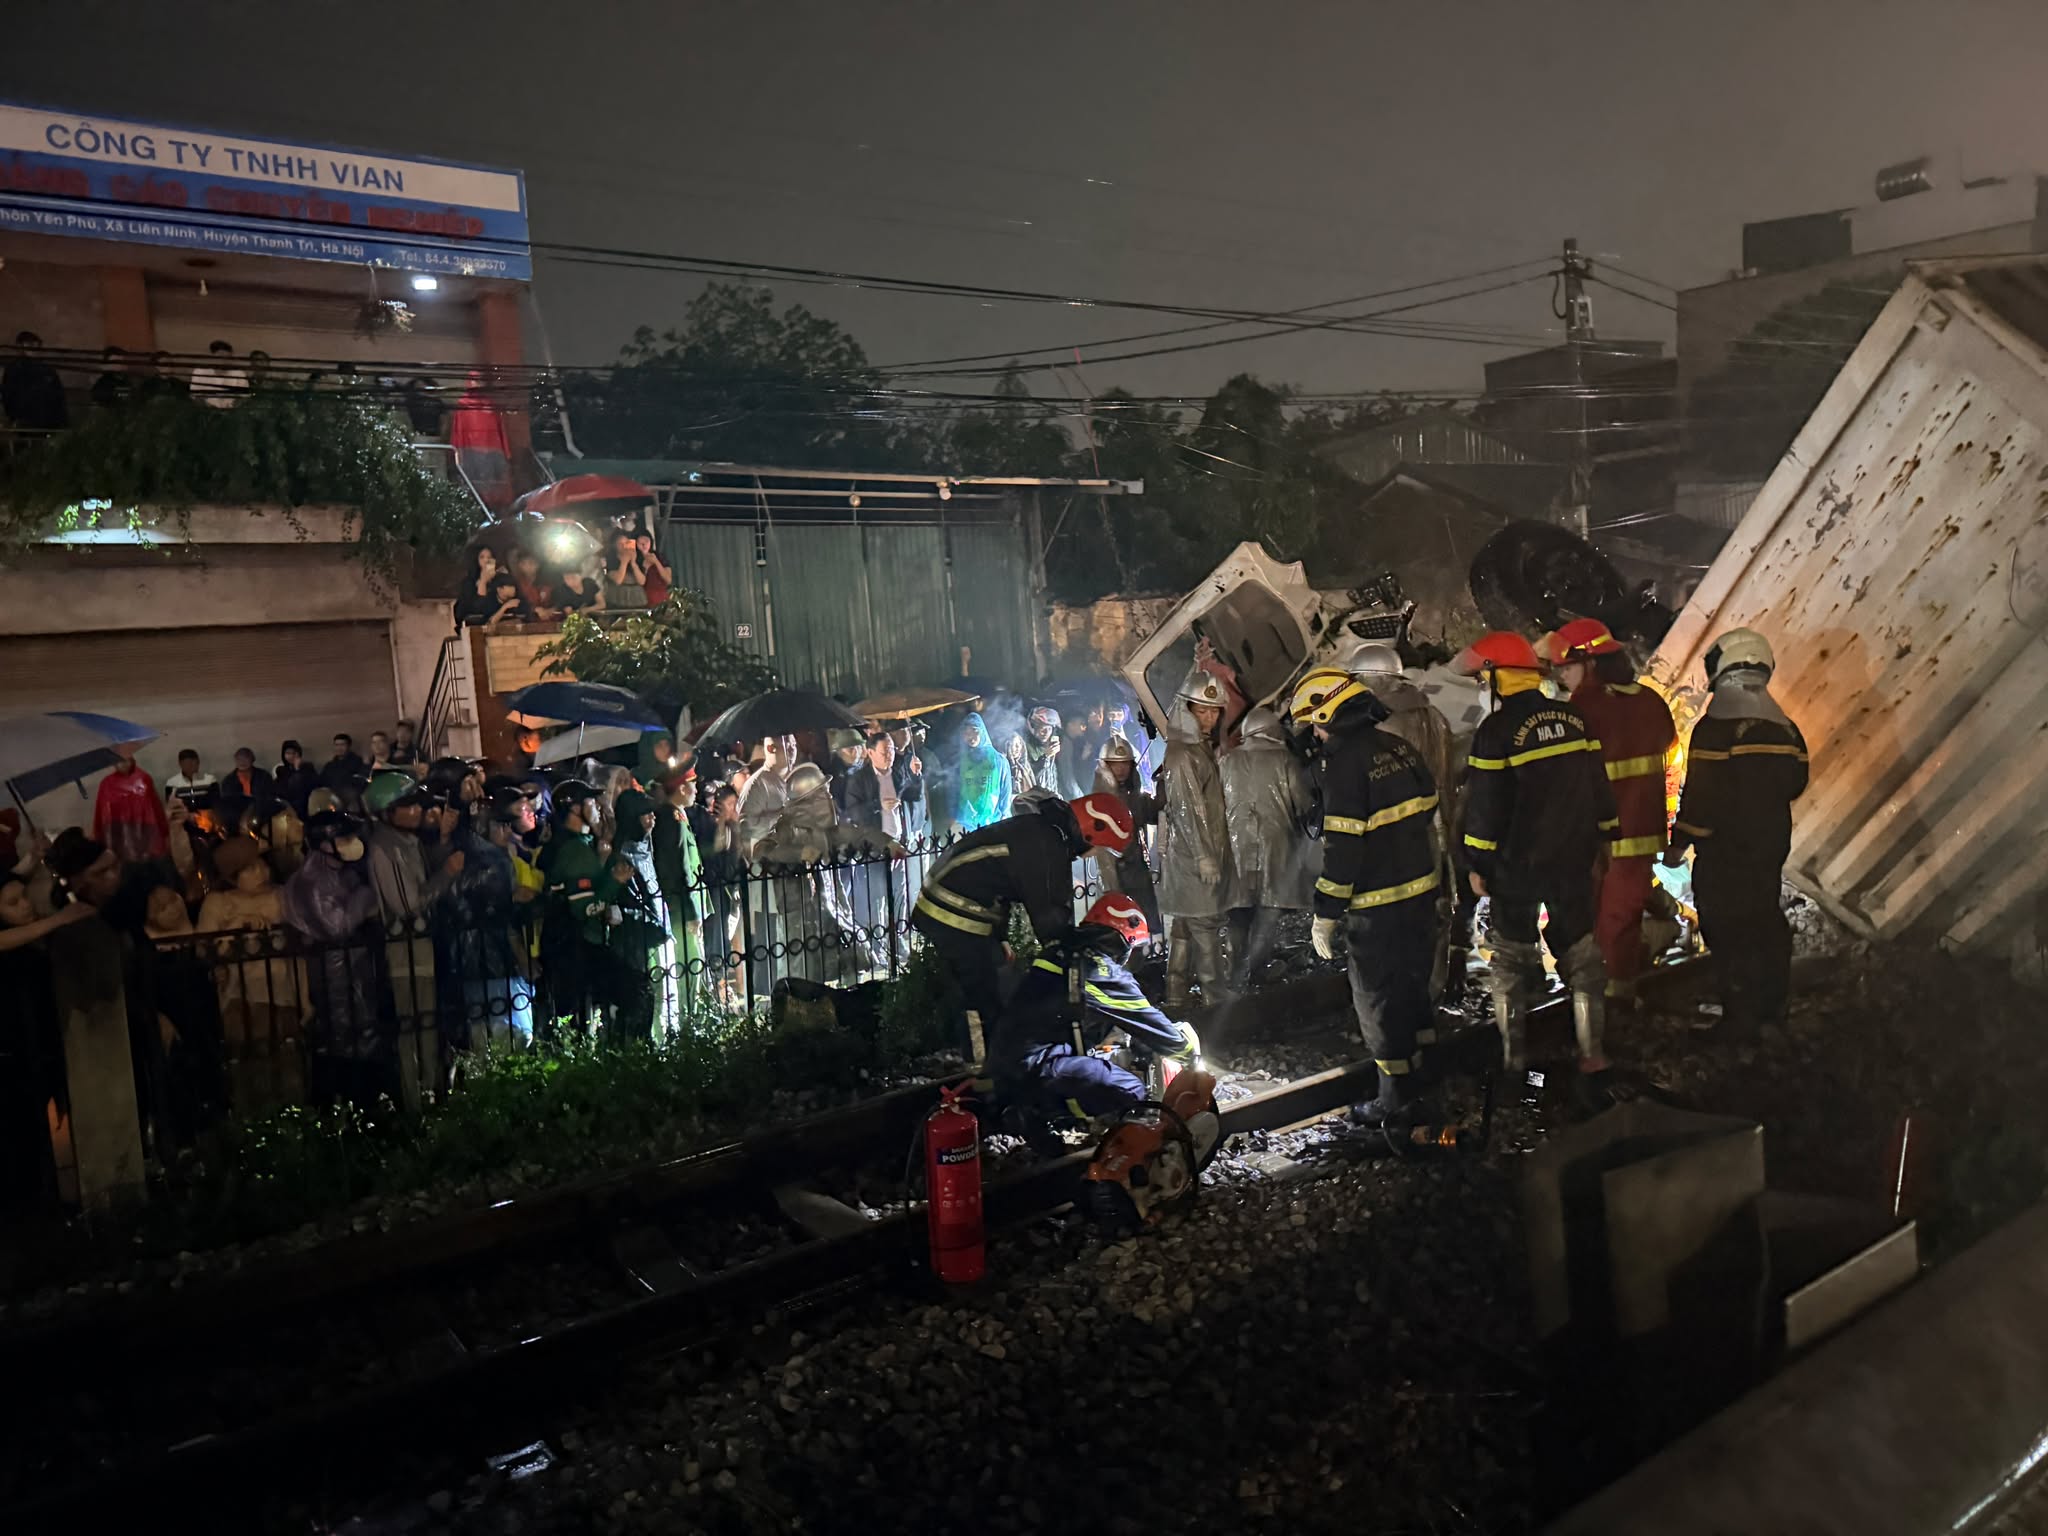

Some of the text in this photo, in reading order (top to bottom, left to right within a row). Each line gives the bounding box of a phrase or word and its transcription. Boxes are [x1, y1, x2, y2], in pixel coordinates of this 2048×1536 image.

[46, 121, 404, 192] CÔNG TY TNHH VIAN
[129, 222, 160, 236] Liên
[204, 229, 248, 246] Huyện
[253, 235, 293, 250] Thanh
[321, 242, 340, 254] Hà
[343, 243, 364, 258] Nội
[737, 625, 750, 636] 22
